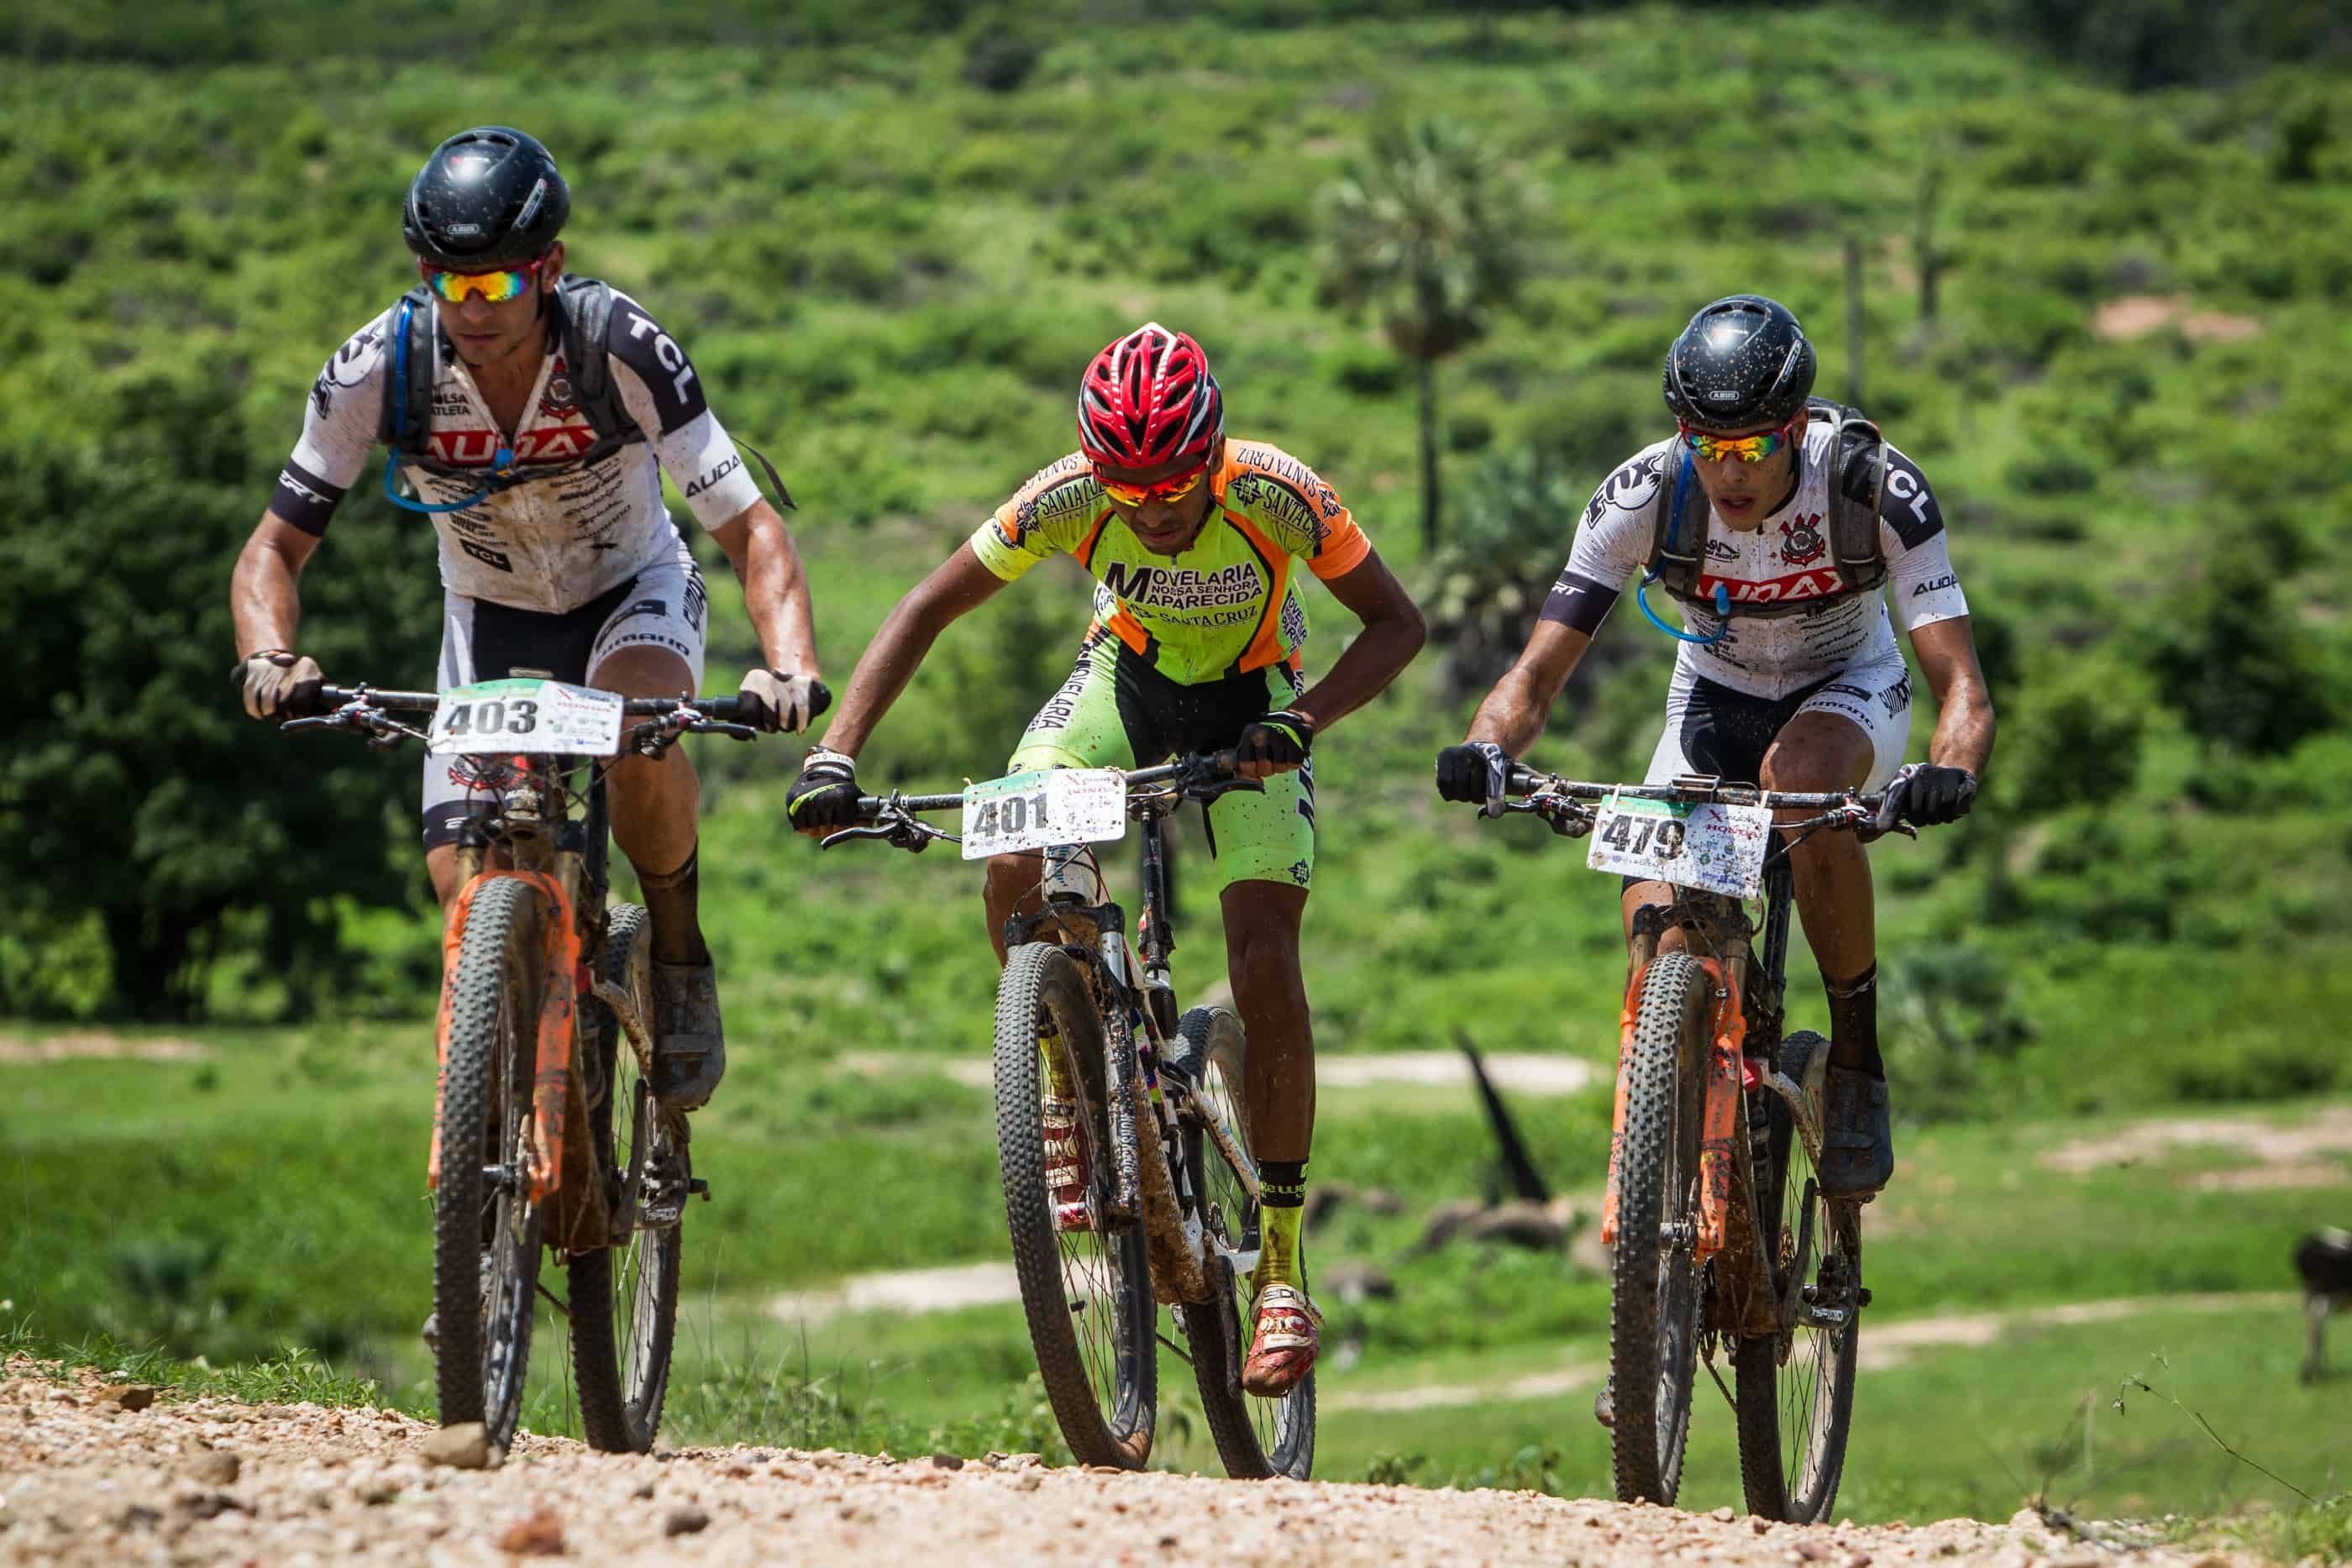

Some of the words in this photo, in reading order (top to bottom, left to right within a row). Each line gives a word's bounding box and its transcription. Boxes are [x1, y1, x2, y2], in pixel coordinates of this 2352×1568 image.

[628, 312, 694, 405] TCL
[1277, 459, 1318, 497] SANTA
[1585, 451, 1665, 529] FOX
[1887, 463, 1929, 525] CL
[1038, 484, 1084, 516] SANTA
[1263, 485, 1305, 525] SANTA
[1105, 561, 1257, 602] MOVELARIA
[1147, 587, 1263, 611] APARECIDA
[1152, 585, 1194, 595] NOSSA
[1196, 581, 1260, 594] SENHORA
[1161, 611, 1211, 627] SANTA
[1214, 605, 1257, 626] CRUZ
[444, 699, 538, 736] 403
[973, 793, 1048, 836] 401
[1603, 814, 1686, 860] 479
